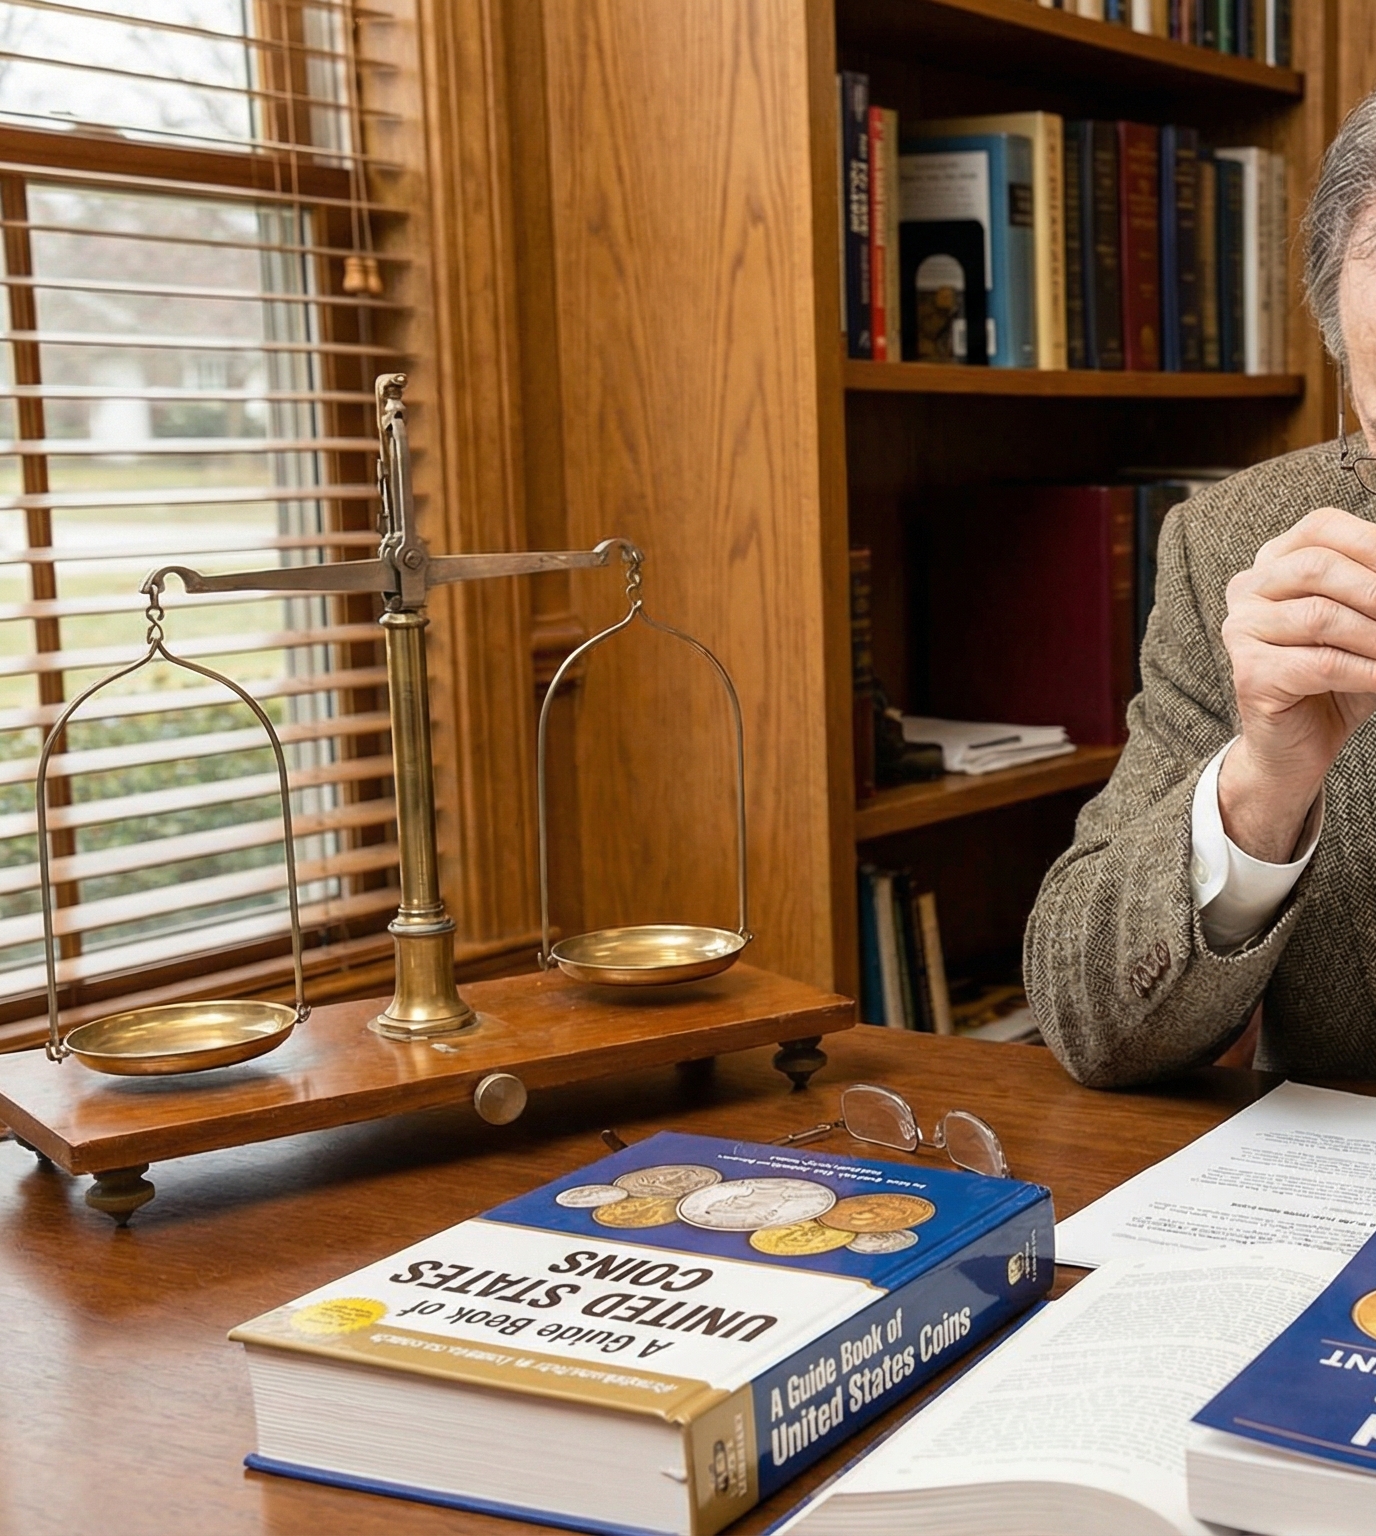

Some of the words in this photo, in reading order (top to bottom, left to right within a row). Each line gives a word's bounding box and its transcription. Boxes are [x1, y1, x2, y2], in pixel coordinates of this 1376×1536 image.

[389, 1260, 580, 1309] STATES
[547, 1250, 714, 1292] COINS
[399, 1300, 446, 1318] of
[446, 1306, 536, 1337] Book
[581, 1293, 778, 1342] UNITED
[536, 1323, 636, 1358] Guide
[636, 1339, 675, 1358] A
[770, 1387, 784, 1423] A
[786, 1356, 837, 1410] Guide
[840, 1323, 884, 1375] Book
[886, 1307, 903, 1344] of
[771, 1386, 844, 1467] United
[848, 1345, 915, 1413] States
[919, 1306, 972, 1363] Coins
